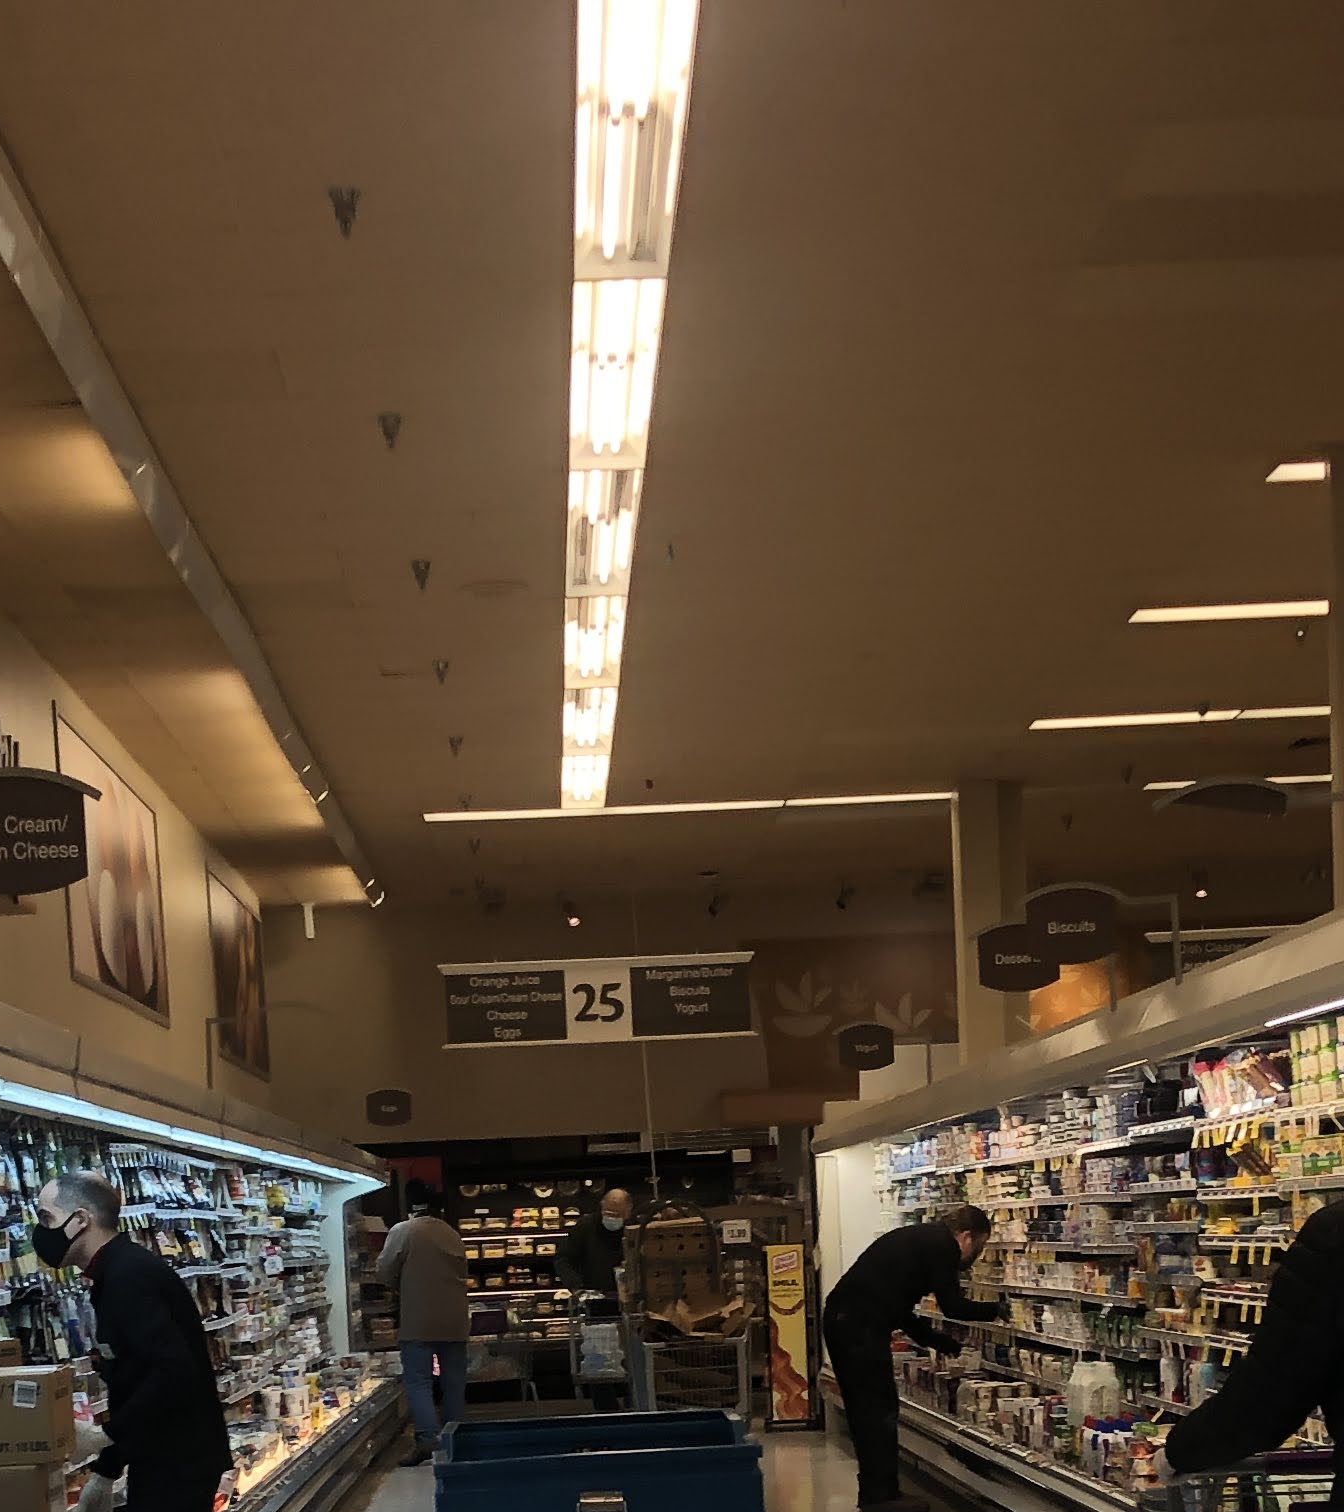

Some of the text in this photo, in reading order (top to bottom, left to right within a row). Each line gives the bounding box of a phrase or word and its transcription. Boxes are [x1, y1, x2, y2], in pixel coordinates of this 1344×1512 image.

[4, 814, 68, 835] Cream/
[13, 841, 79, 862] Cheese
[1047, 920, 1096, 935] Biscuits
[469, 976, 540, 988] Orange Juice
[669, 985, 711, 997] Biscuits
[572, 982, 624, 1022] 25
[486, 1010, 528, 1021] Cheese
[674, 1003, 708, 1015] Yogurt
[493, 1027, 522, 1040] Eggs
